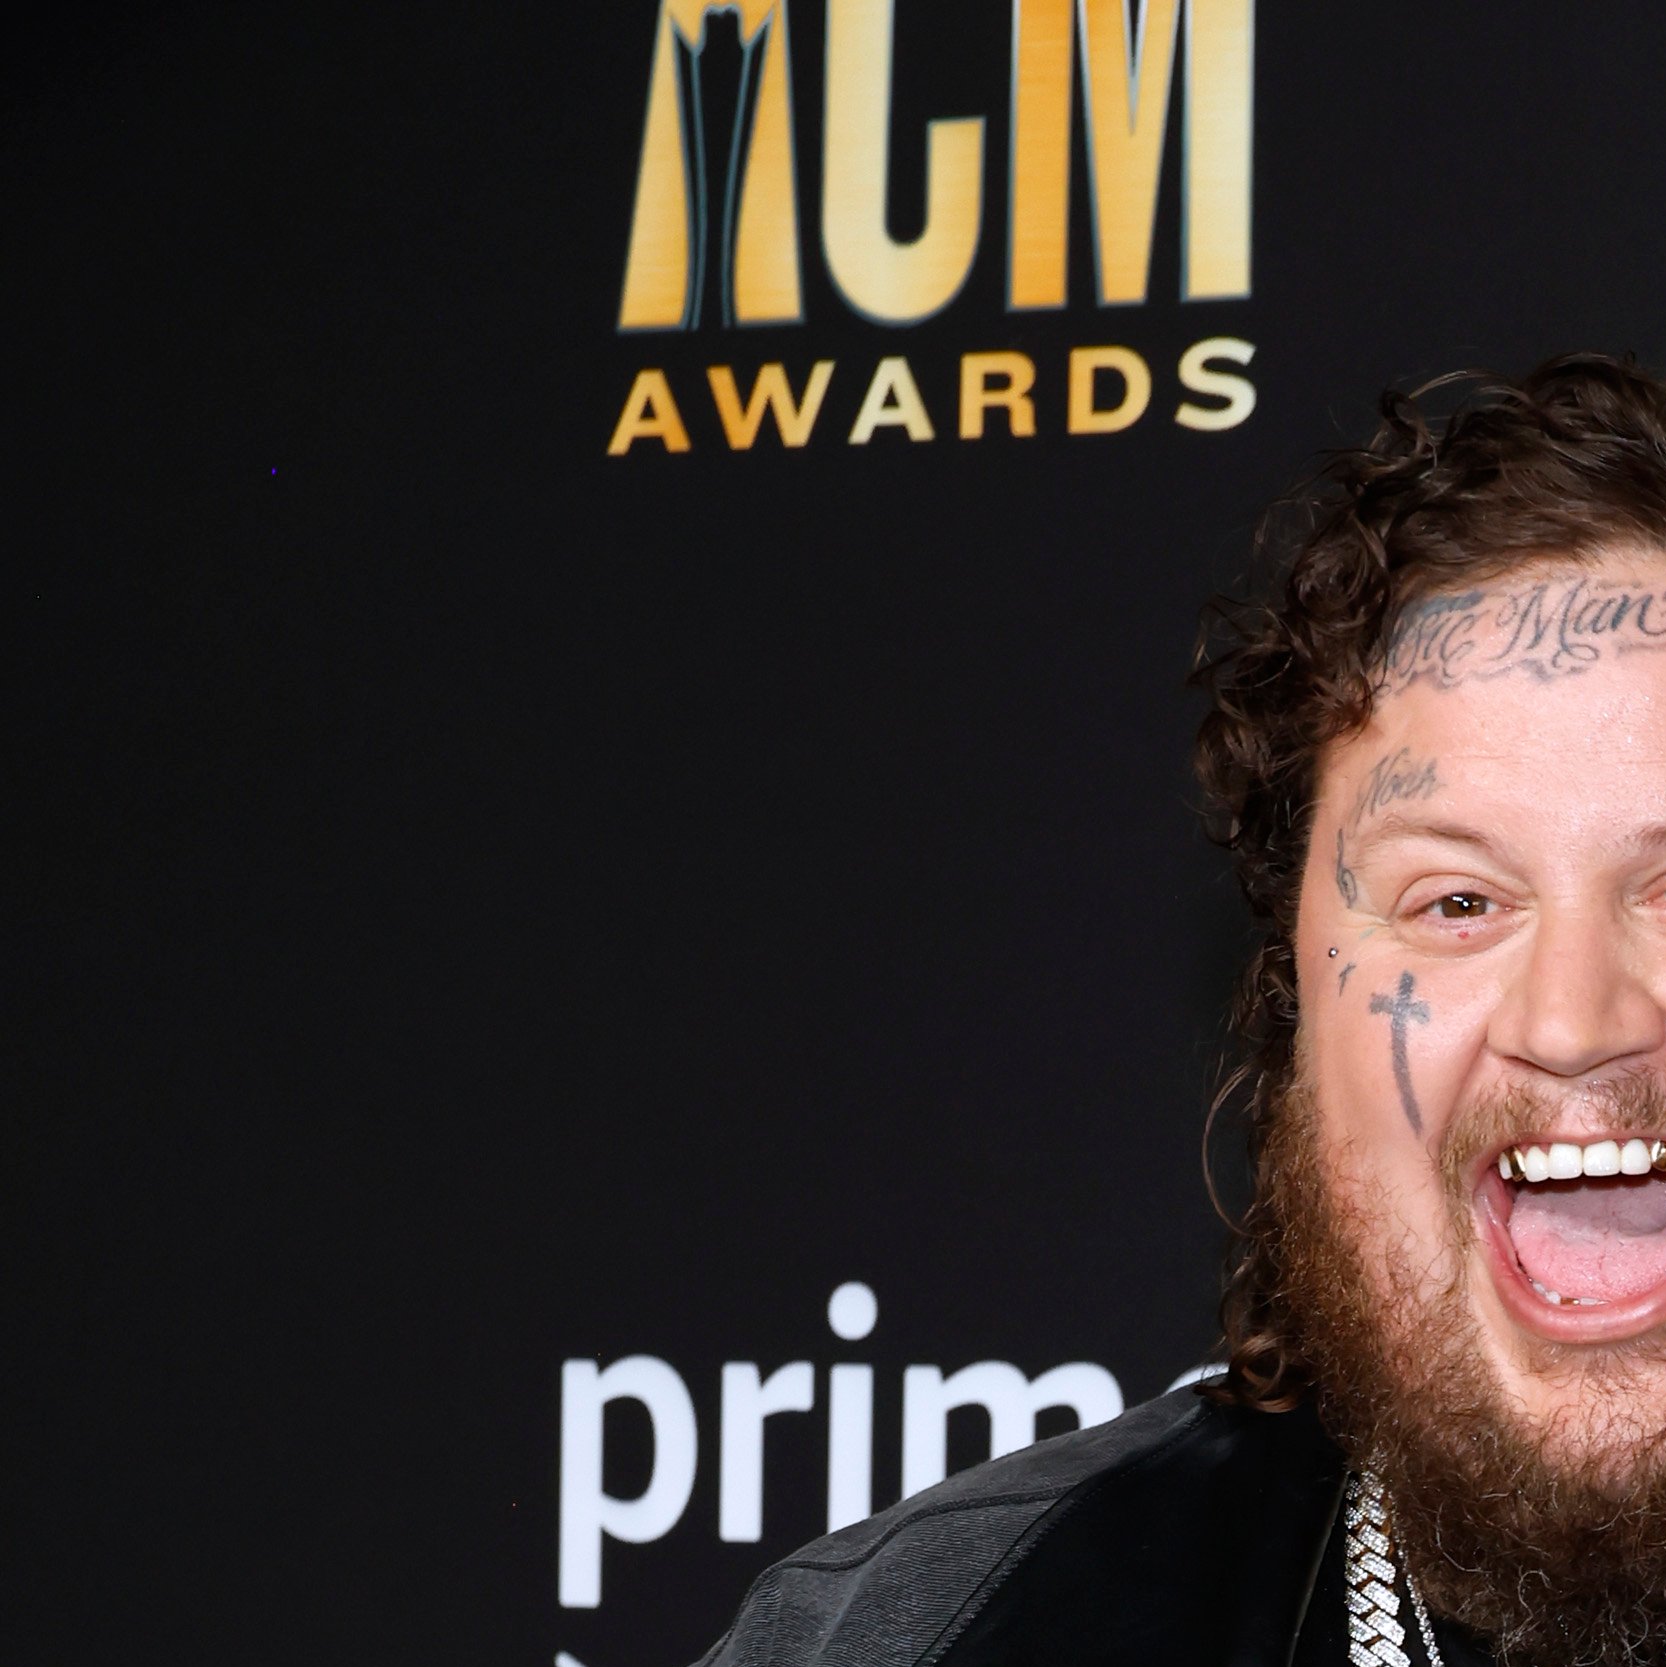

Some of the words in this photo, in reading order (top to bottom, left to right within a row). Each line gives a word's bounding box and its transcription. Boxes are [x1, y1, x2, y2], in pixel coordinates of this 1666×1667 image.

[615, 0, 1257, 333] ACM
[605, 336, 1258, 457] AWARDS
[556, 1280, 1231, 1609] prim
